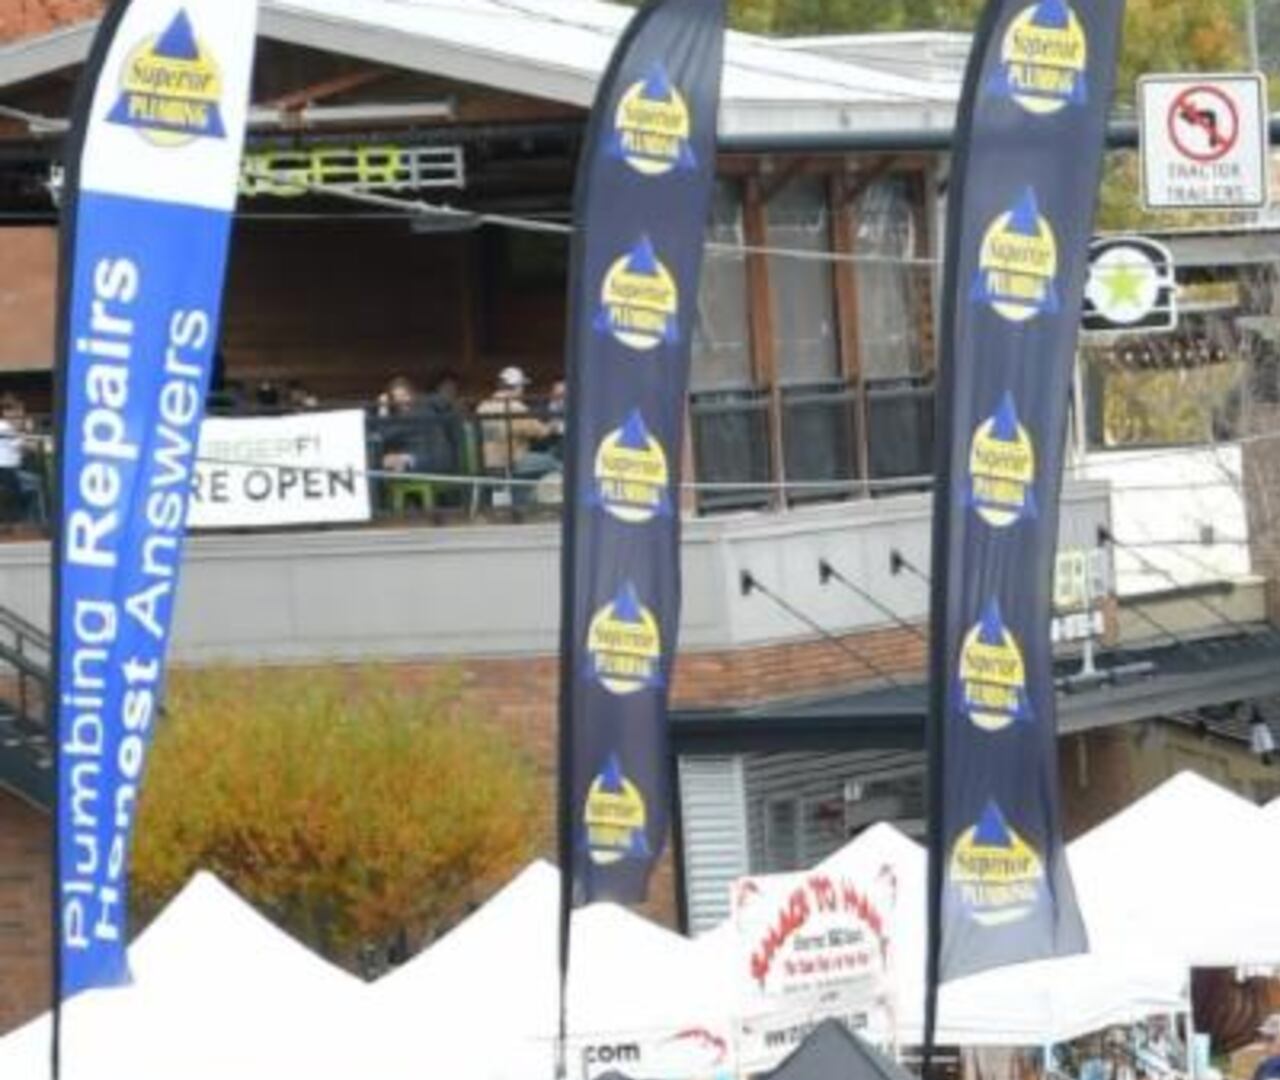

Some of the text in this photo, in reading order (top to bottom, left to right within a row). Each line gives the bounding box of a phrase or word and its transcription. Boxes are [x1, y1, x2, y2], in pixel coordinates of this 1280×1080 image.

[1167, 162, 1240, 180] TRACTOR
[62, 256, 140, 950] Plumbing Repairs
[94, 308, 210, 942] Honest Answers
[243, 465, 357, 502] OPEN
